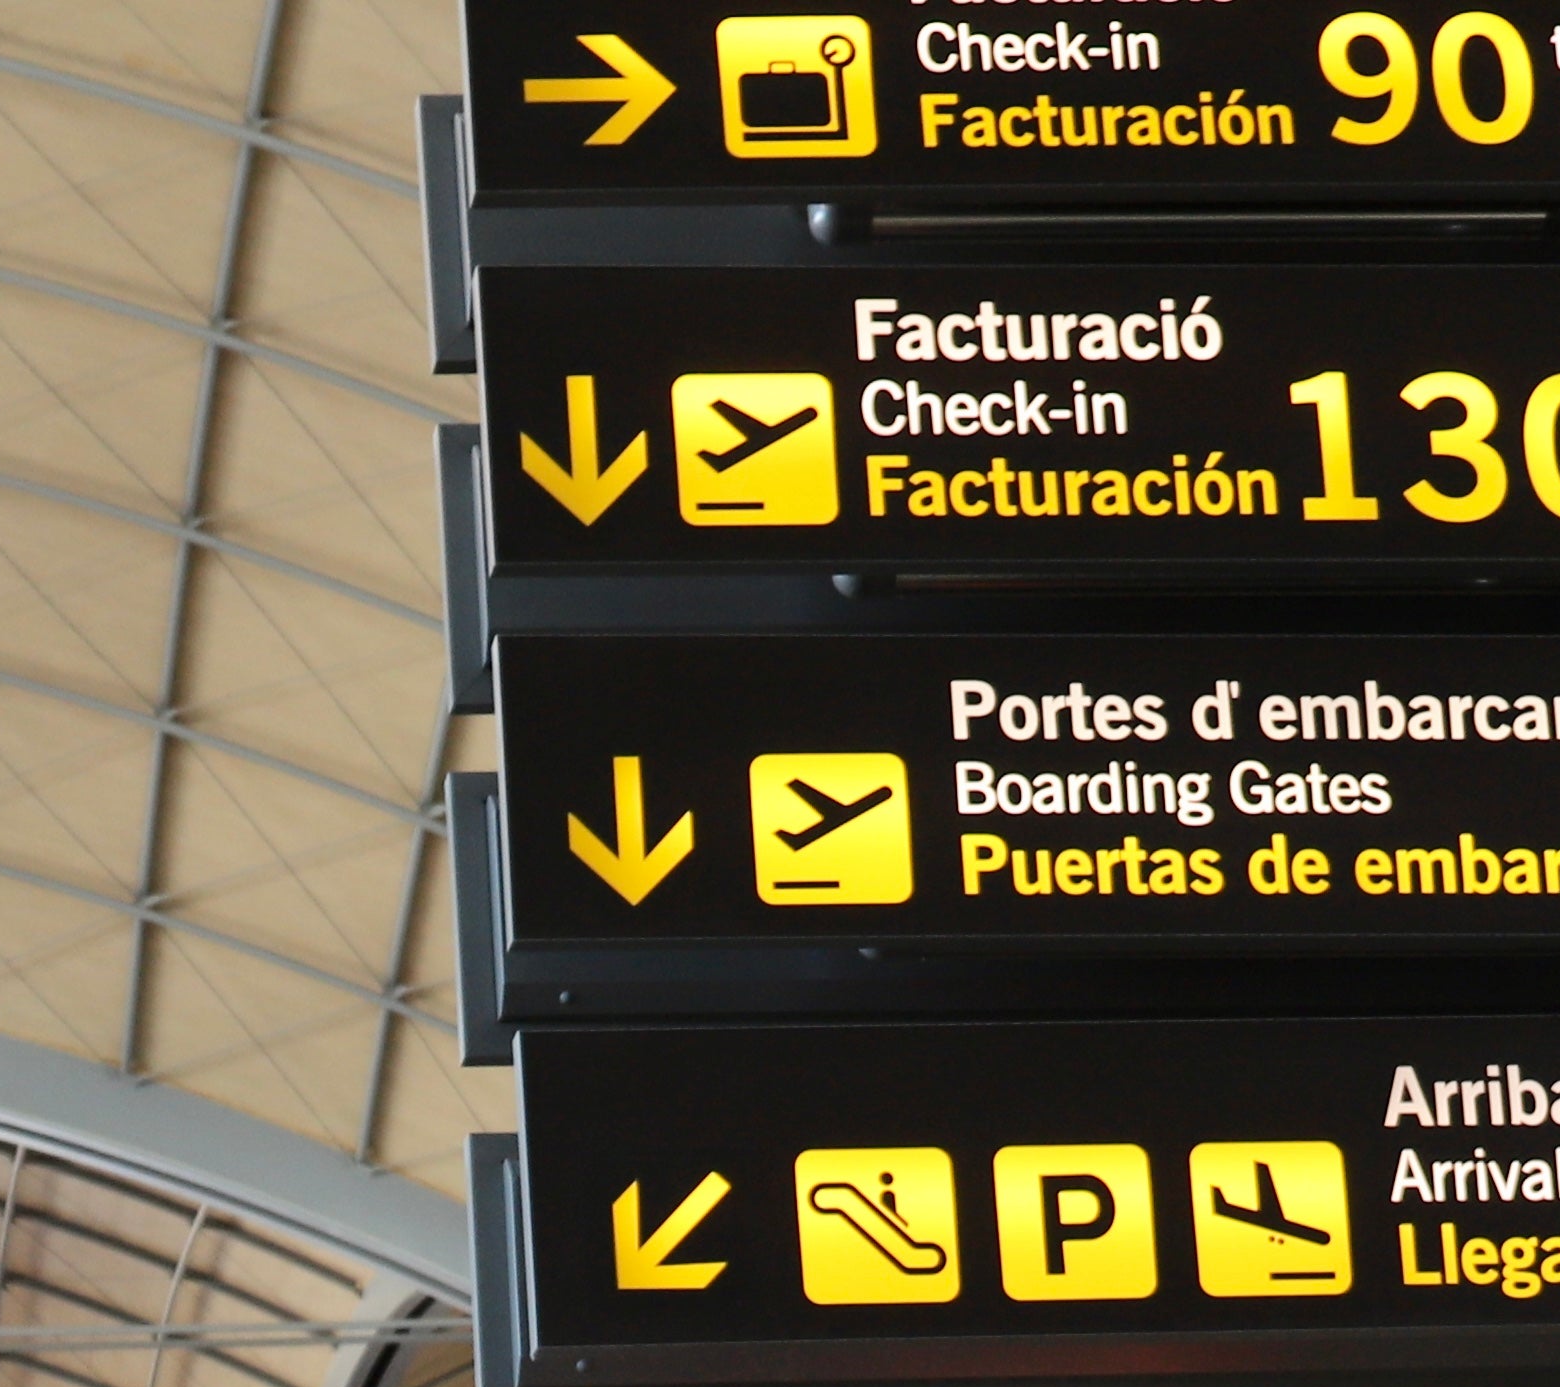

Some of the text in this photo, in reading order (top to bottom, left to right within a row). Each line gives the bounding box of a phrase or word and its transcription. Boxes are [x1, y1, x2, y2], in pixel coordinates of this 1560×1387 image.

[916, 21, 1160, 73] Check-in
[1318, 10, 1534, 145] 90
[920, 88, 1295, 148] Facturación
[854, 295, 1223, 362] Facturació
[861, 379, 1128, 436] Check-in
[866, 451, 1278, 517] Facturación
[949, 680, 1168, 742] Portes
[955, 760, 1393, 826] Boarding Gates
[961, 833, 1225, 896] Puertas
[1248, 833, 1330, 895] de
